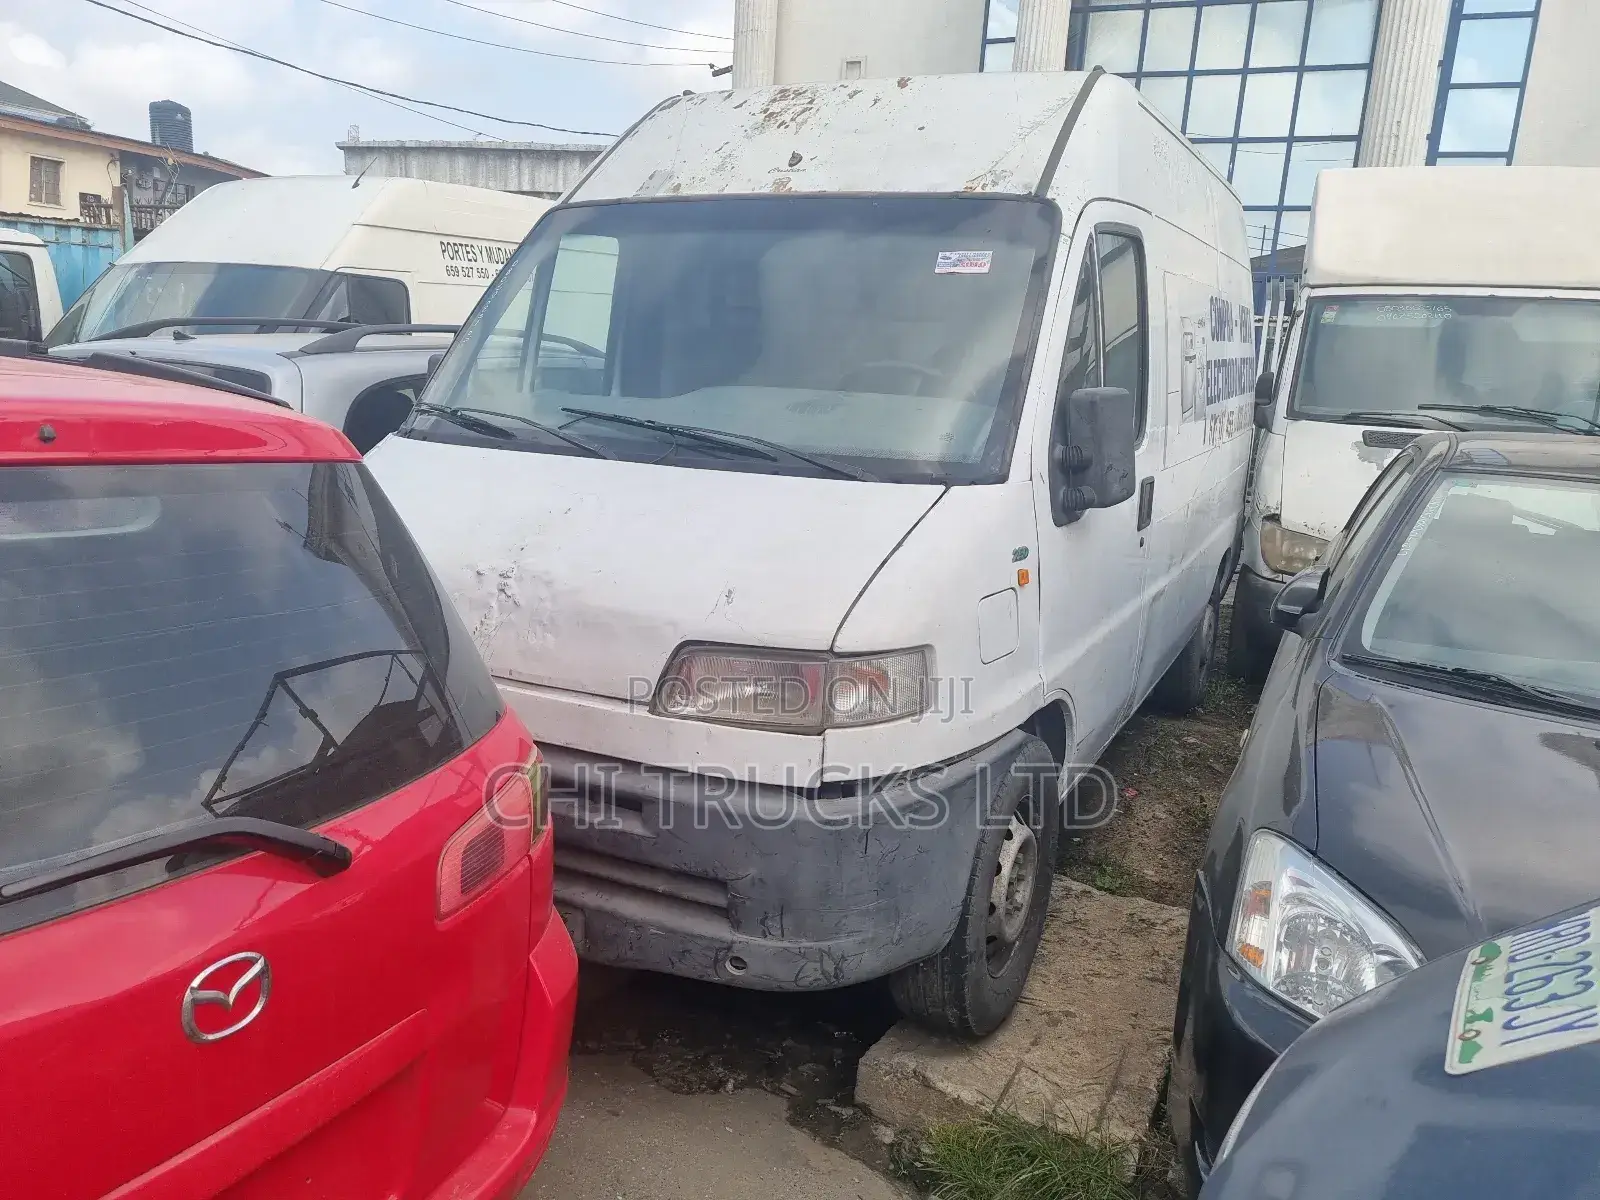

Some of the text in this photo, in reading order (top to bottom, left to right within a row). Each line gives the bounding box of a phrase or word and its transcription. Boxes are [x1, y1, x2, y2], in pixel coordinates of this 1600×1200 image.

[439, 240, 478, 262] PORTES
[477, 244, 485, 263] Y
[445, 265, 460, 277] 659
[461, 266, 474, 278] 527
[476, 267, 490, 279] 550
